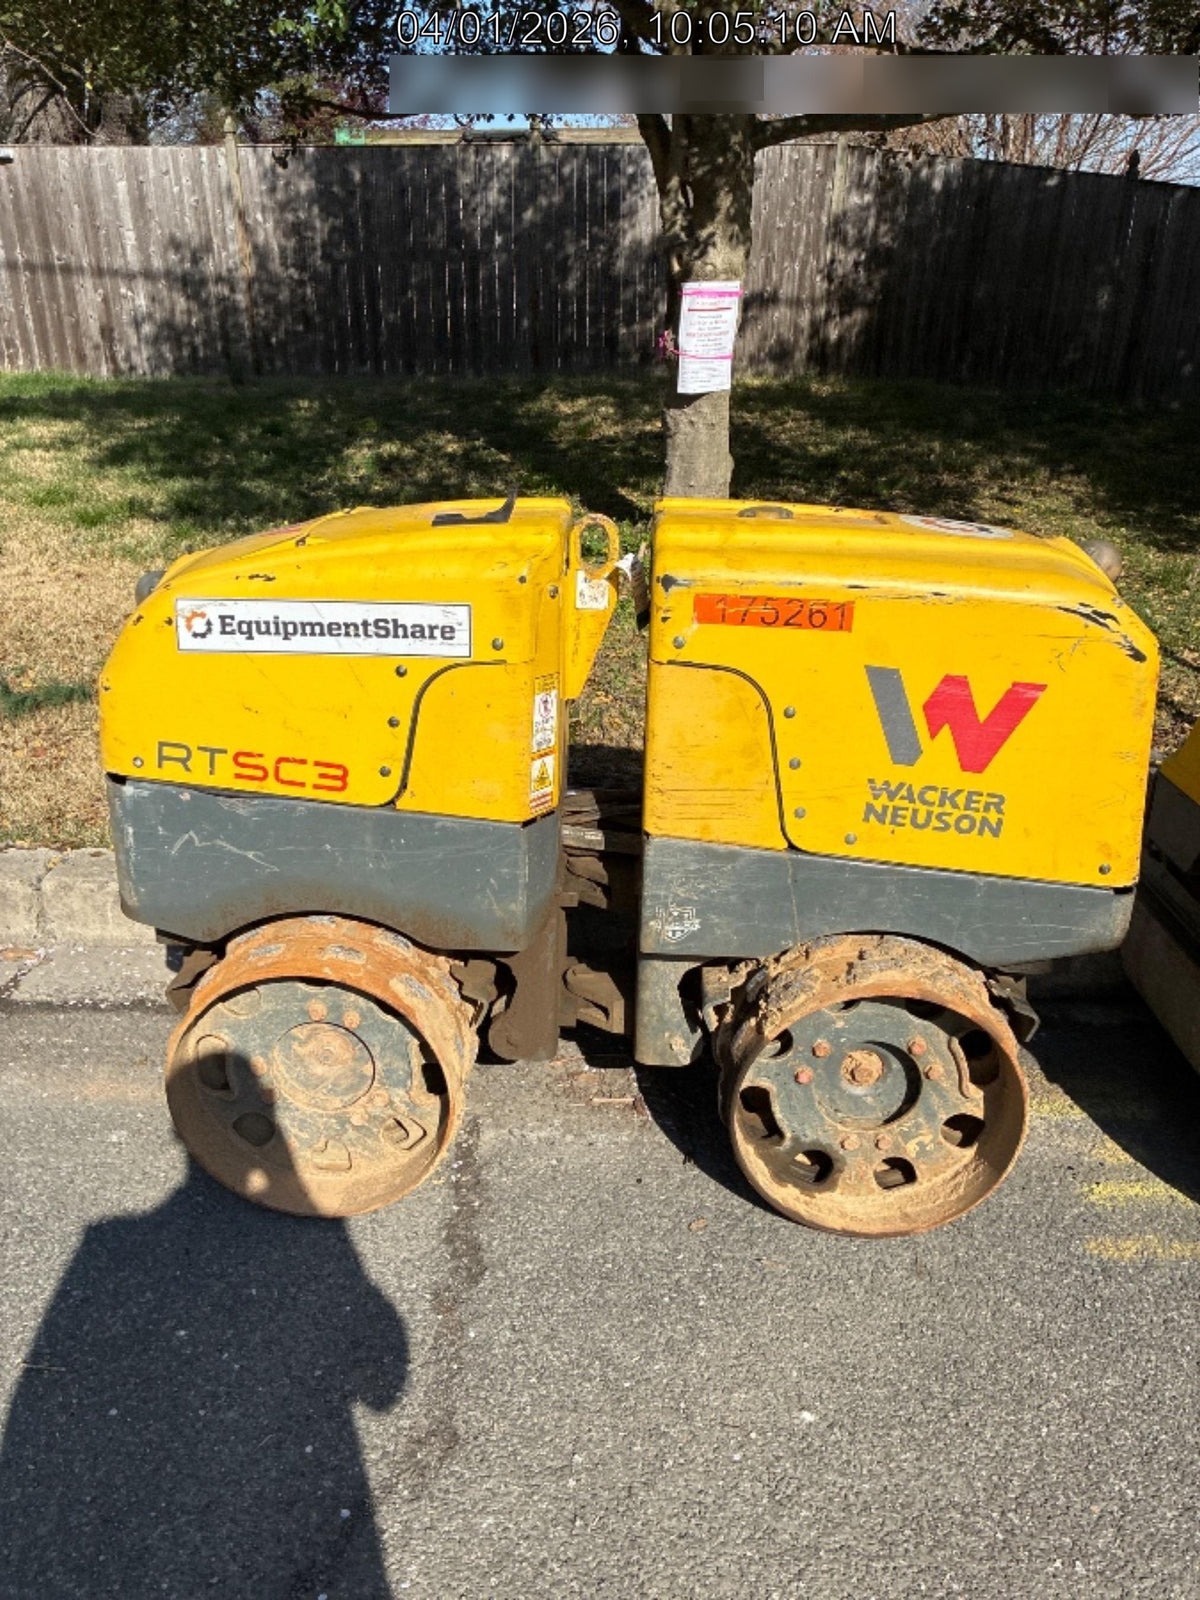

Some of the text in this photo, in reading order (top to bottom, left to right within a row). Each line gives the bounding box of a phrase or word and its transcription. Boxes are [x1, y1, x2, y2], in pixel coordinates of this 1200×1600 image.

[218, 614, 456, 641] EquipmentShare
[716, 595, 846, 630] 175261
[157, 741, 349, 792] RTSC3
[867, 778, 1006, 815] WACKER
[862, 802, 1004, 838] NEUSON
